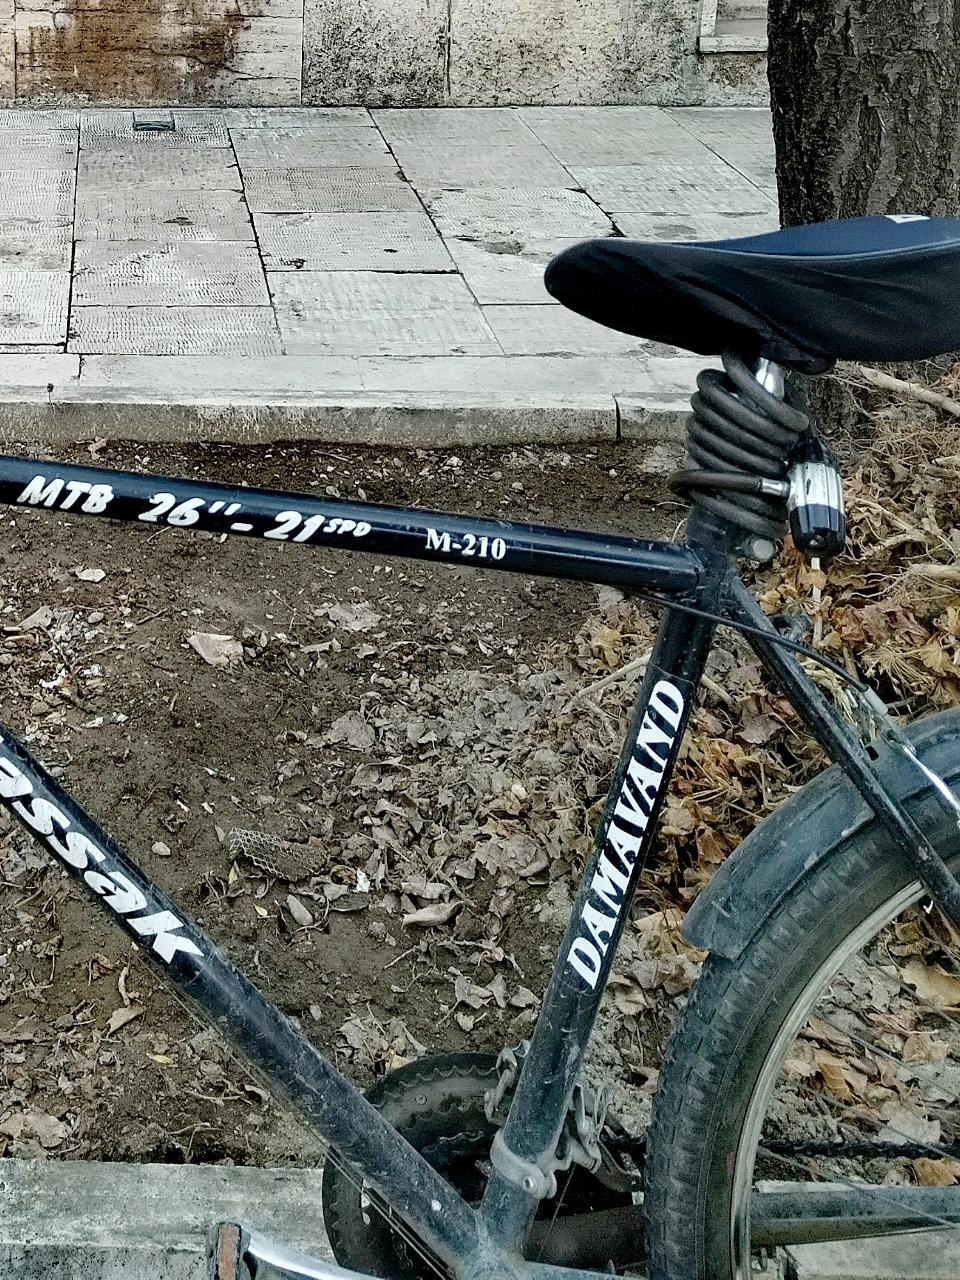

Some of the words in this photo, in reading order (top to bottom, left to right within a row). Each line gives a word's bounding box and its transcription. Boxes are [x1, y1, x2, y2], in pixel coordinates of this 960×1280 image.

[16, 475, 115, 514] MTB
[425, 527, 507, 561] M-210
[567, 680, 685, 991] DAMAVAND
